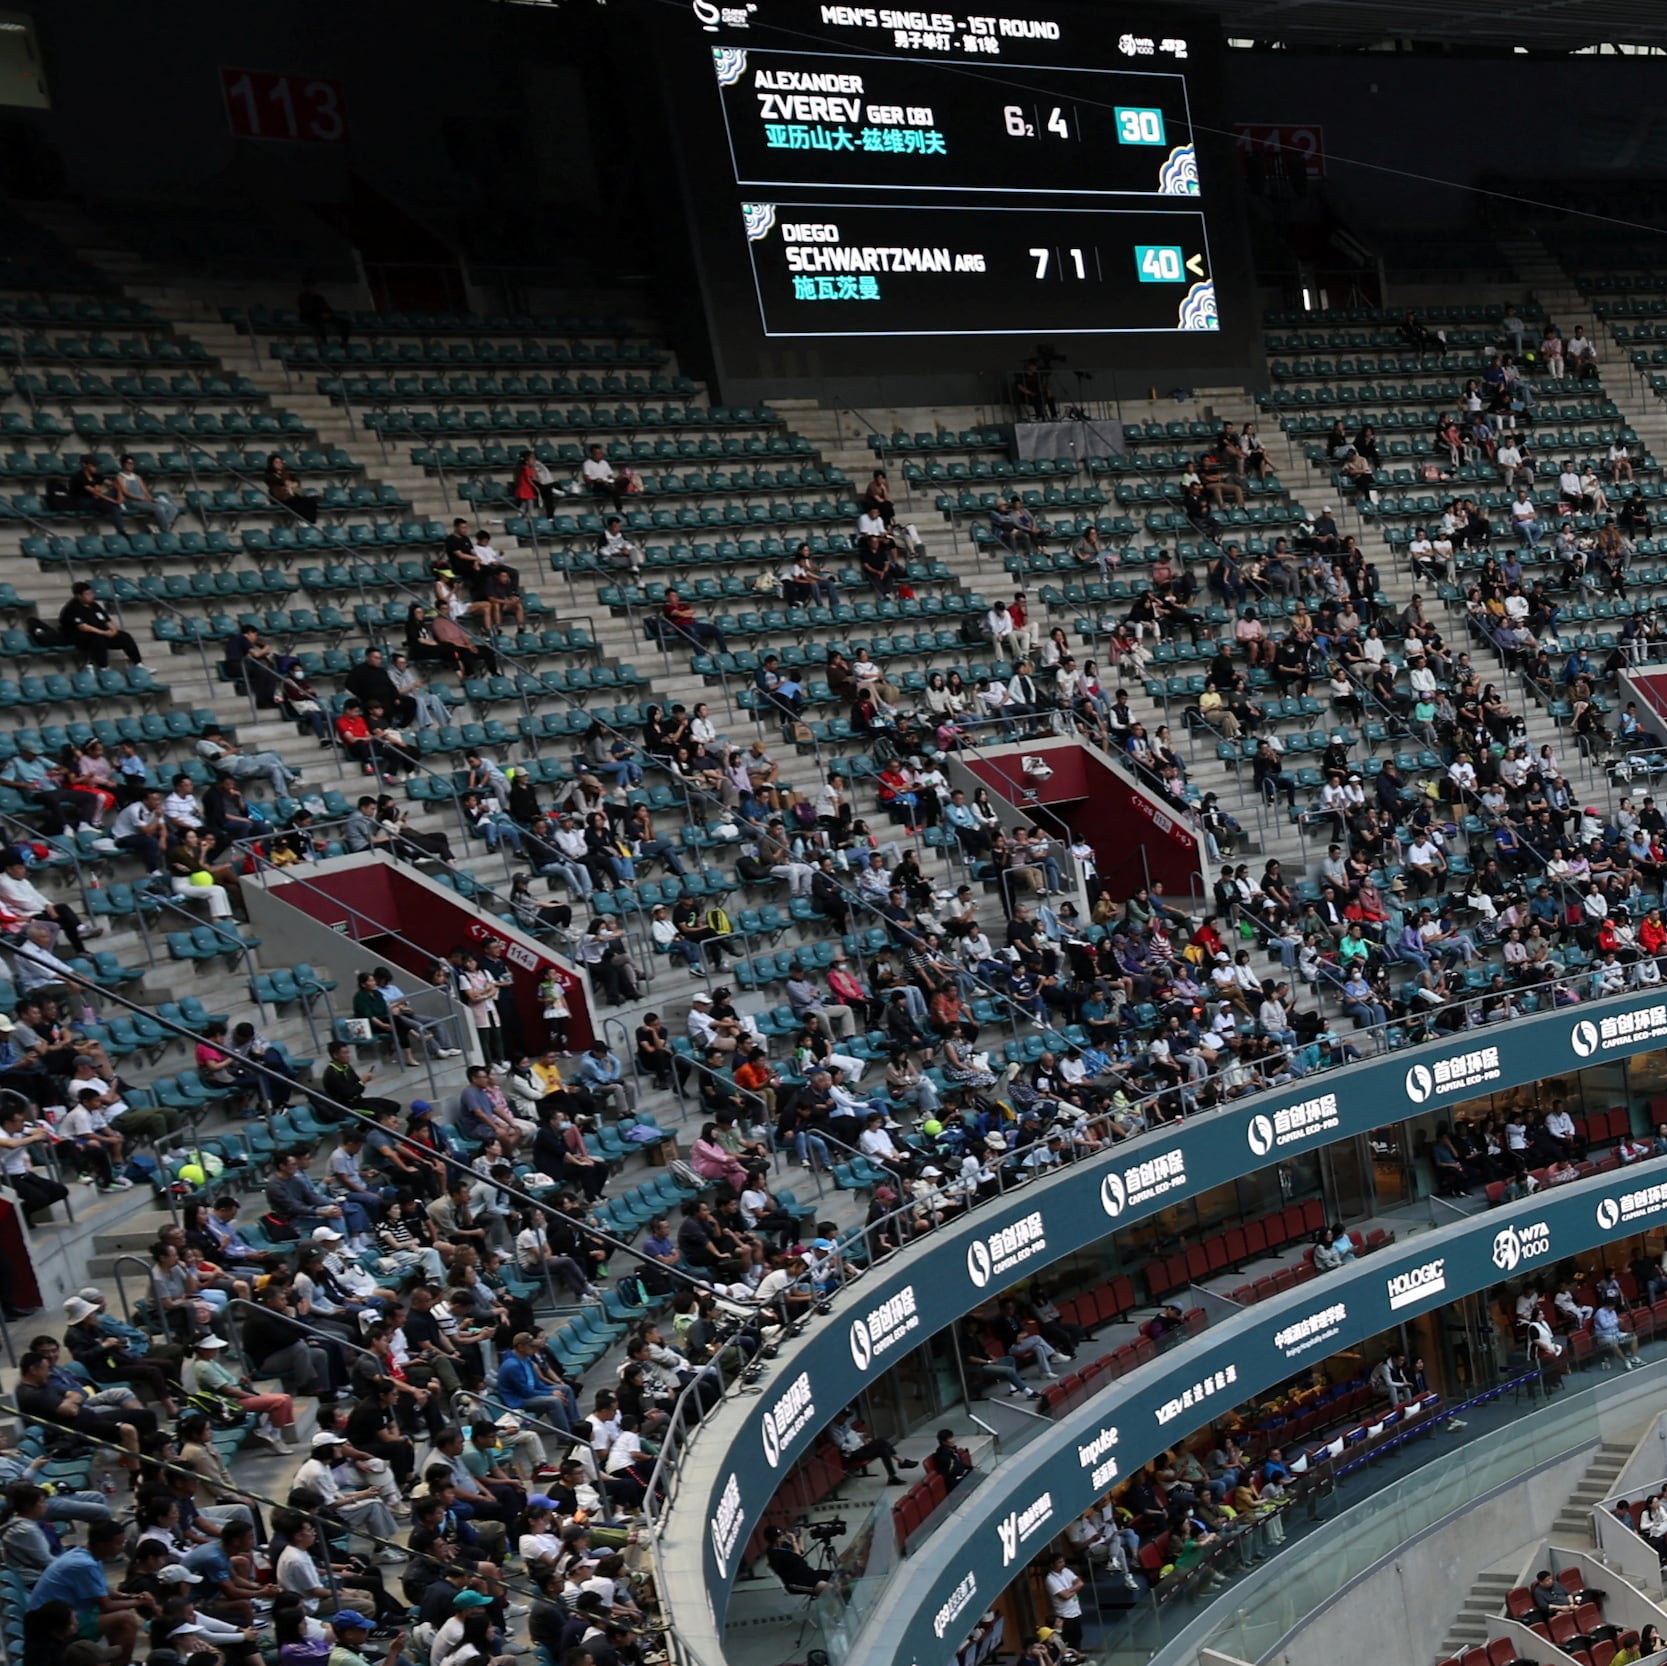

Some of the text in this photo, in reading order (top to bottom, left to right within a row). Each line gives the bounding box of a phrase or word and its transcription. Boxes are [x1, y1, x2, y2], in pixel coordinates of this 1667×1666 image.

[821, 5, 1061, 41] MEN'S SINGLES 1ST ROUND
[894, 30, 1000, 54] 男子单打 第1轮
[754, 69, 865, 94] ALEXANDER
[230, 73, 343, 140] 113
[757, 93, 935, 127] ZVEREV GER [8]
[1003, 105, 1026, 137] 6
[1047, 107, 1069, 139] 4
[763, 123, 948, 156] 亚历山大-兹维列夫
[1119, 110, 1161, 143] 30
[781, 223, 839, 244] DIEGO
[785, 246, 986, 273] SCHWARTZMAN ARG
[1029, 248, 1049, 280] 7
[1069, 248, 1086, 280] 1
[1141, 248, 1179, 280] 40
[791, 274, 881, 301] 施瓦茨曼
[1599, 1005, 1667, 1040] 首创环保
[1433, 1047, 1499, 1083] 首创环保
[1273, 1093, 1338, 1135] 首创环保
[1124, 1148, 1184, 1194] 首创环保
[988, 1211, 1043, 1262] 首创环保
[1518, 1222, 1550, 1253] WTA
[1520, 1235, 1549, 1261] 1000
[1387, 1260, 1444, 1297] HOLOGIC
[867, 1284, 918, 1333] 首创环保
[1078, 1427, 1119, 1464] impulse
